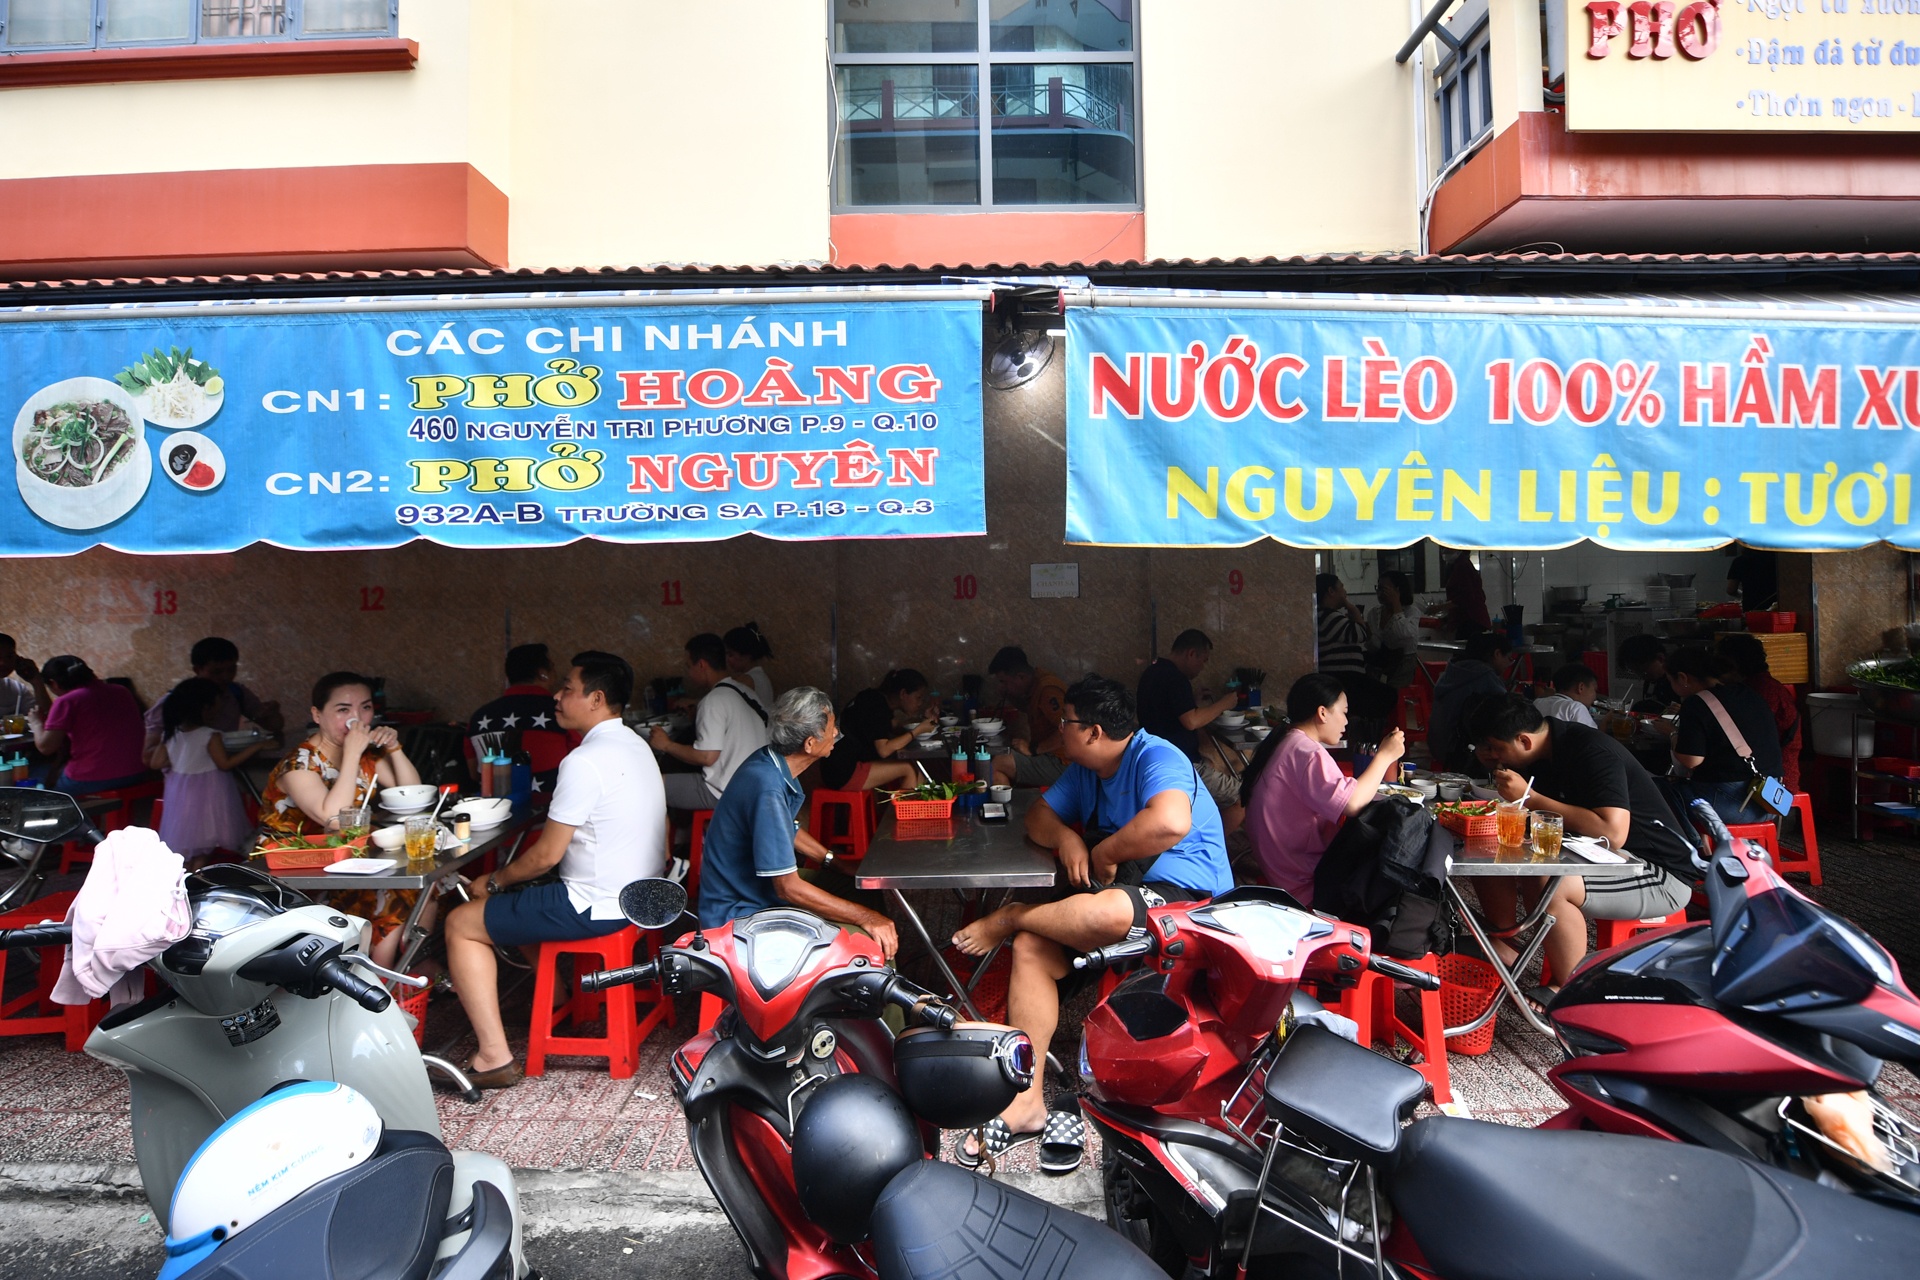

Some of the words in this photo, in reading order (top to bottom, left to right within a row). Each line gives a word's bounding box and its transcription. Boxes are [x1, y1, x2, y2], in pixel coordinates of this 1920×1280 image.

[1748, 38, 1805, 72] Đậm
[1852, 37, 1884, 65] từ
[1748, 89, 1823, 117] Thơm
[1832, 96, 1893, 123] ngon
[386, 322, 505, 356] CÁC
[526, 320, 622, 354] CHI
[645, 316, 848, 351] NHÁNH
[405, 357, 603, 411] PHỞ
[616, 356, 942, 411] HOÀNG
[1088, 334, 1310, 423] NƯỚC
[1322, 336, 1457, 425] LÈO
[1485, 357, 1666, 428] 100%
[1679, 334, 1842, 429] HẦM
[409, 416, 459, 443] 460
[465, 413, 597, 441] NGUYỄN
[604, 419, 653, 440] TRI
[663, 415, 792, 438] PHƯƠNG
[800, 413, 845, 435] P.9
[873, 411, 938, 432] Q.10
[405, 441, 606, 495] PHỞ
[626, 438, 941, 494] NGUYÊN
[1166, 450, 1492, 522] NGUYÊN
[1518, 453, 1681, 539] LIỆU
[1702, 477, 1721, 526] :
[1739, 461, 1910, 527] TƯƠI
[395, 501, 545, 526] 932A-B
[556, 500, 707, 523] TRƯỜNG
[717, 501, 769, 521] SA
[774, 498, 847, 519] P.13
[876, 498, 935, 517] Q.3
[359, 586, 385, 611] 12
[661, 580, 684, 606] 11
[952, 574, 978, 600] 10
[1228, 570, 1245, 596] 9
[153, 590, 178, 615] 13
